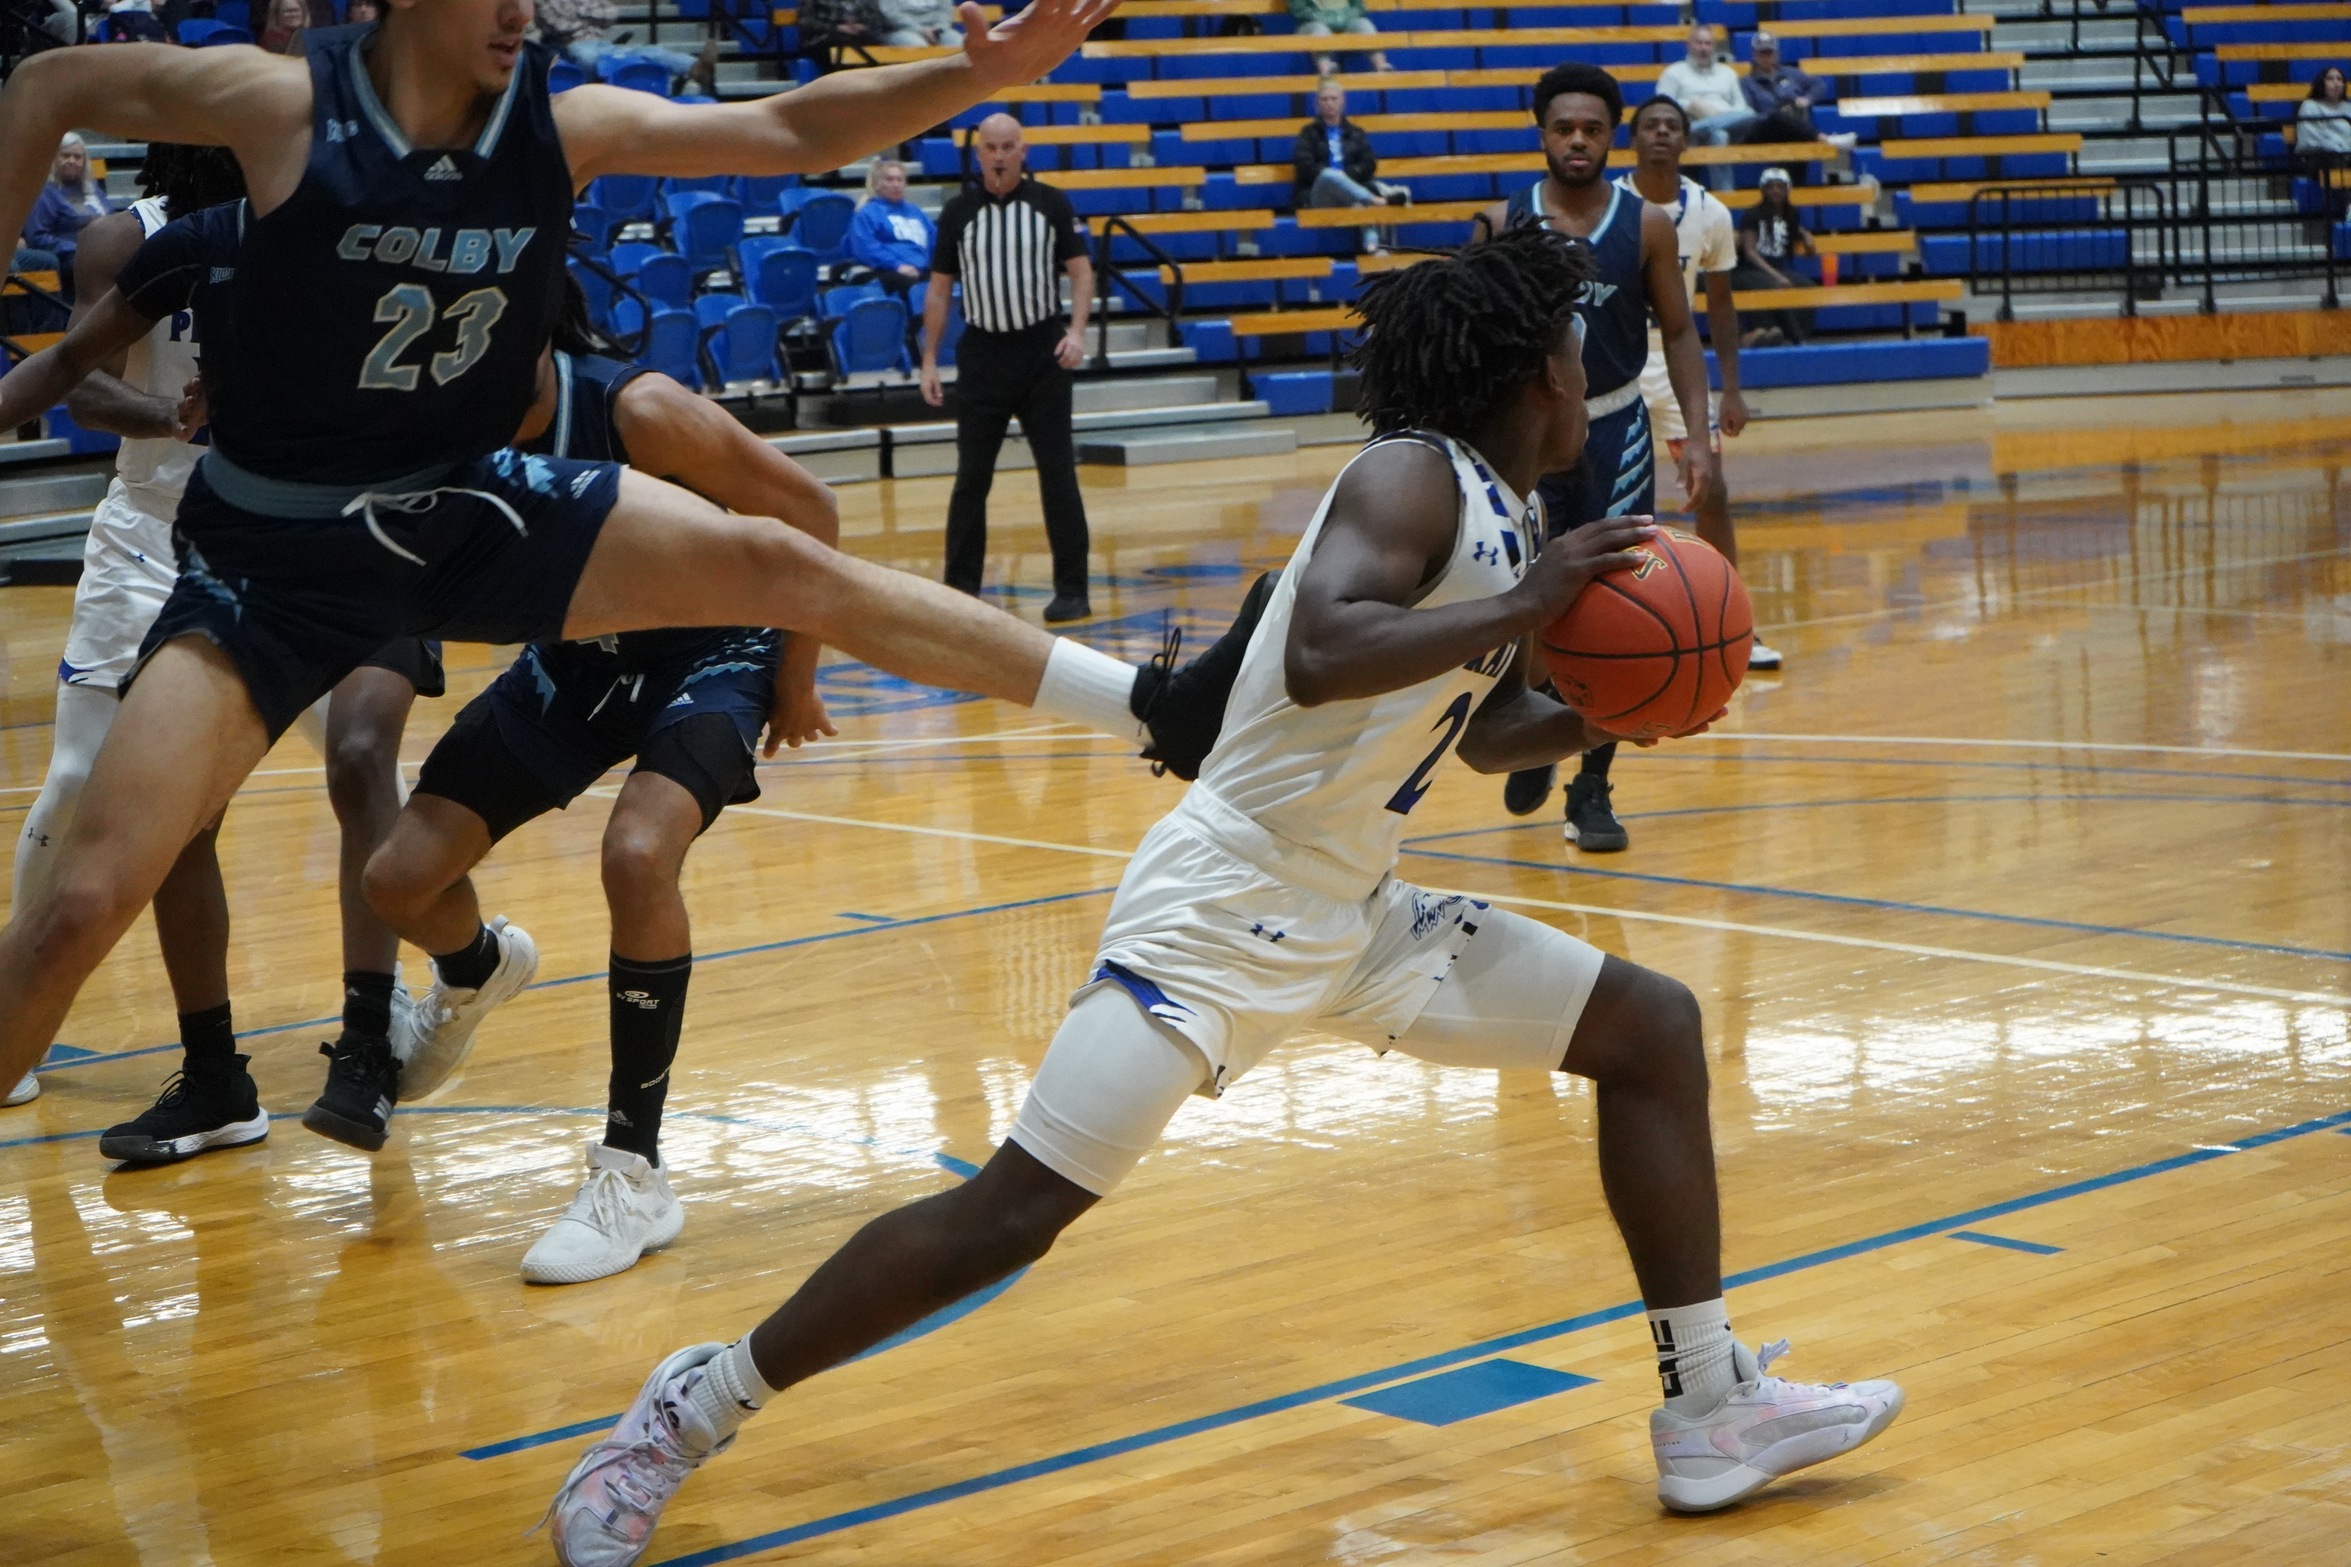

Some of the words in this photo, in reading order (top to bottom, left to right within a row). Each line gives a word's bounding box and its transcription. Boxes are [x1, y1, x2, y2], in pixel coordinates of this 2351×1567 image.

[336, 223, 537, 274] COLBY
[357, 283, 508, 391] 23
[1384, 692, 1473, 815] 2
